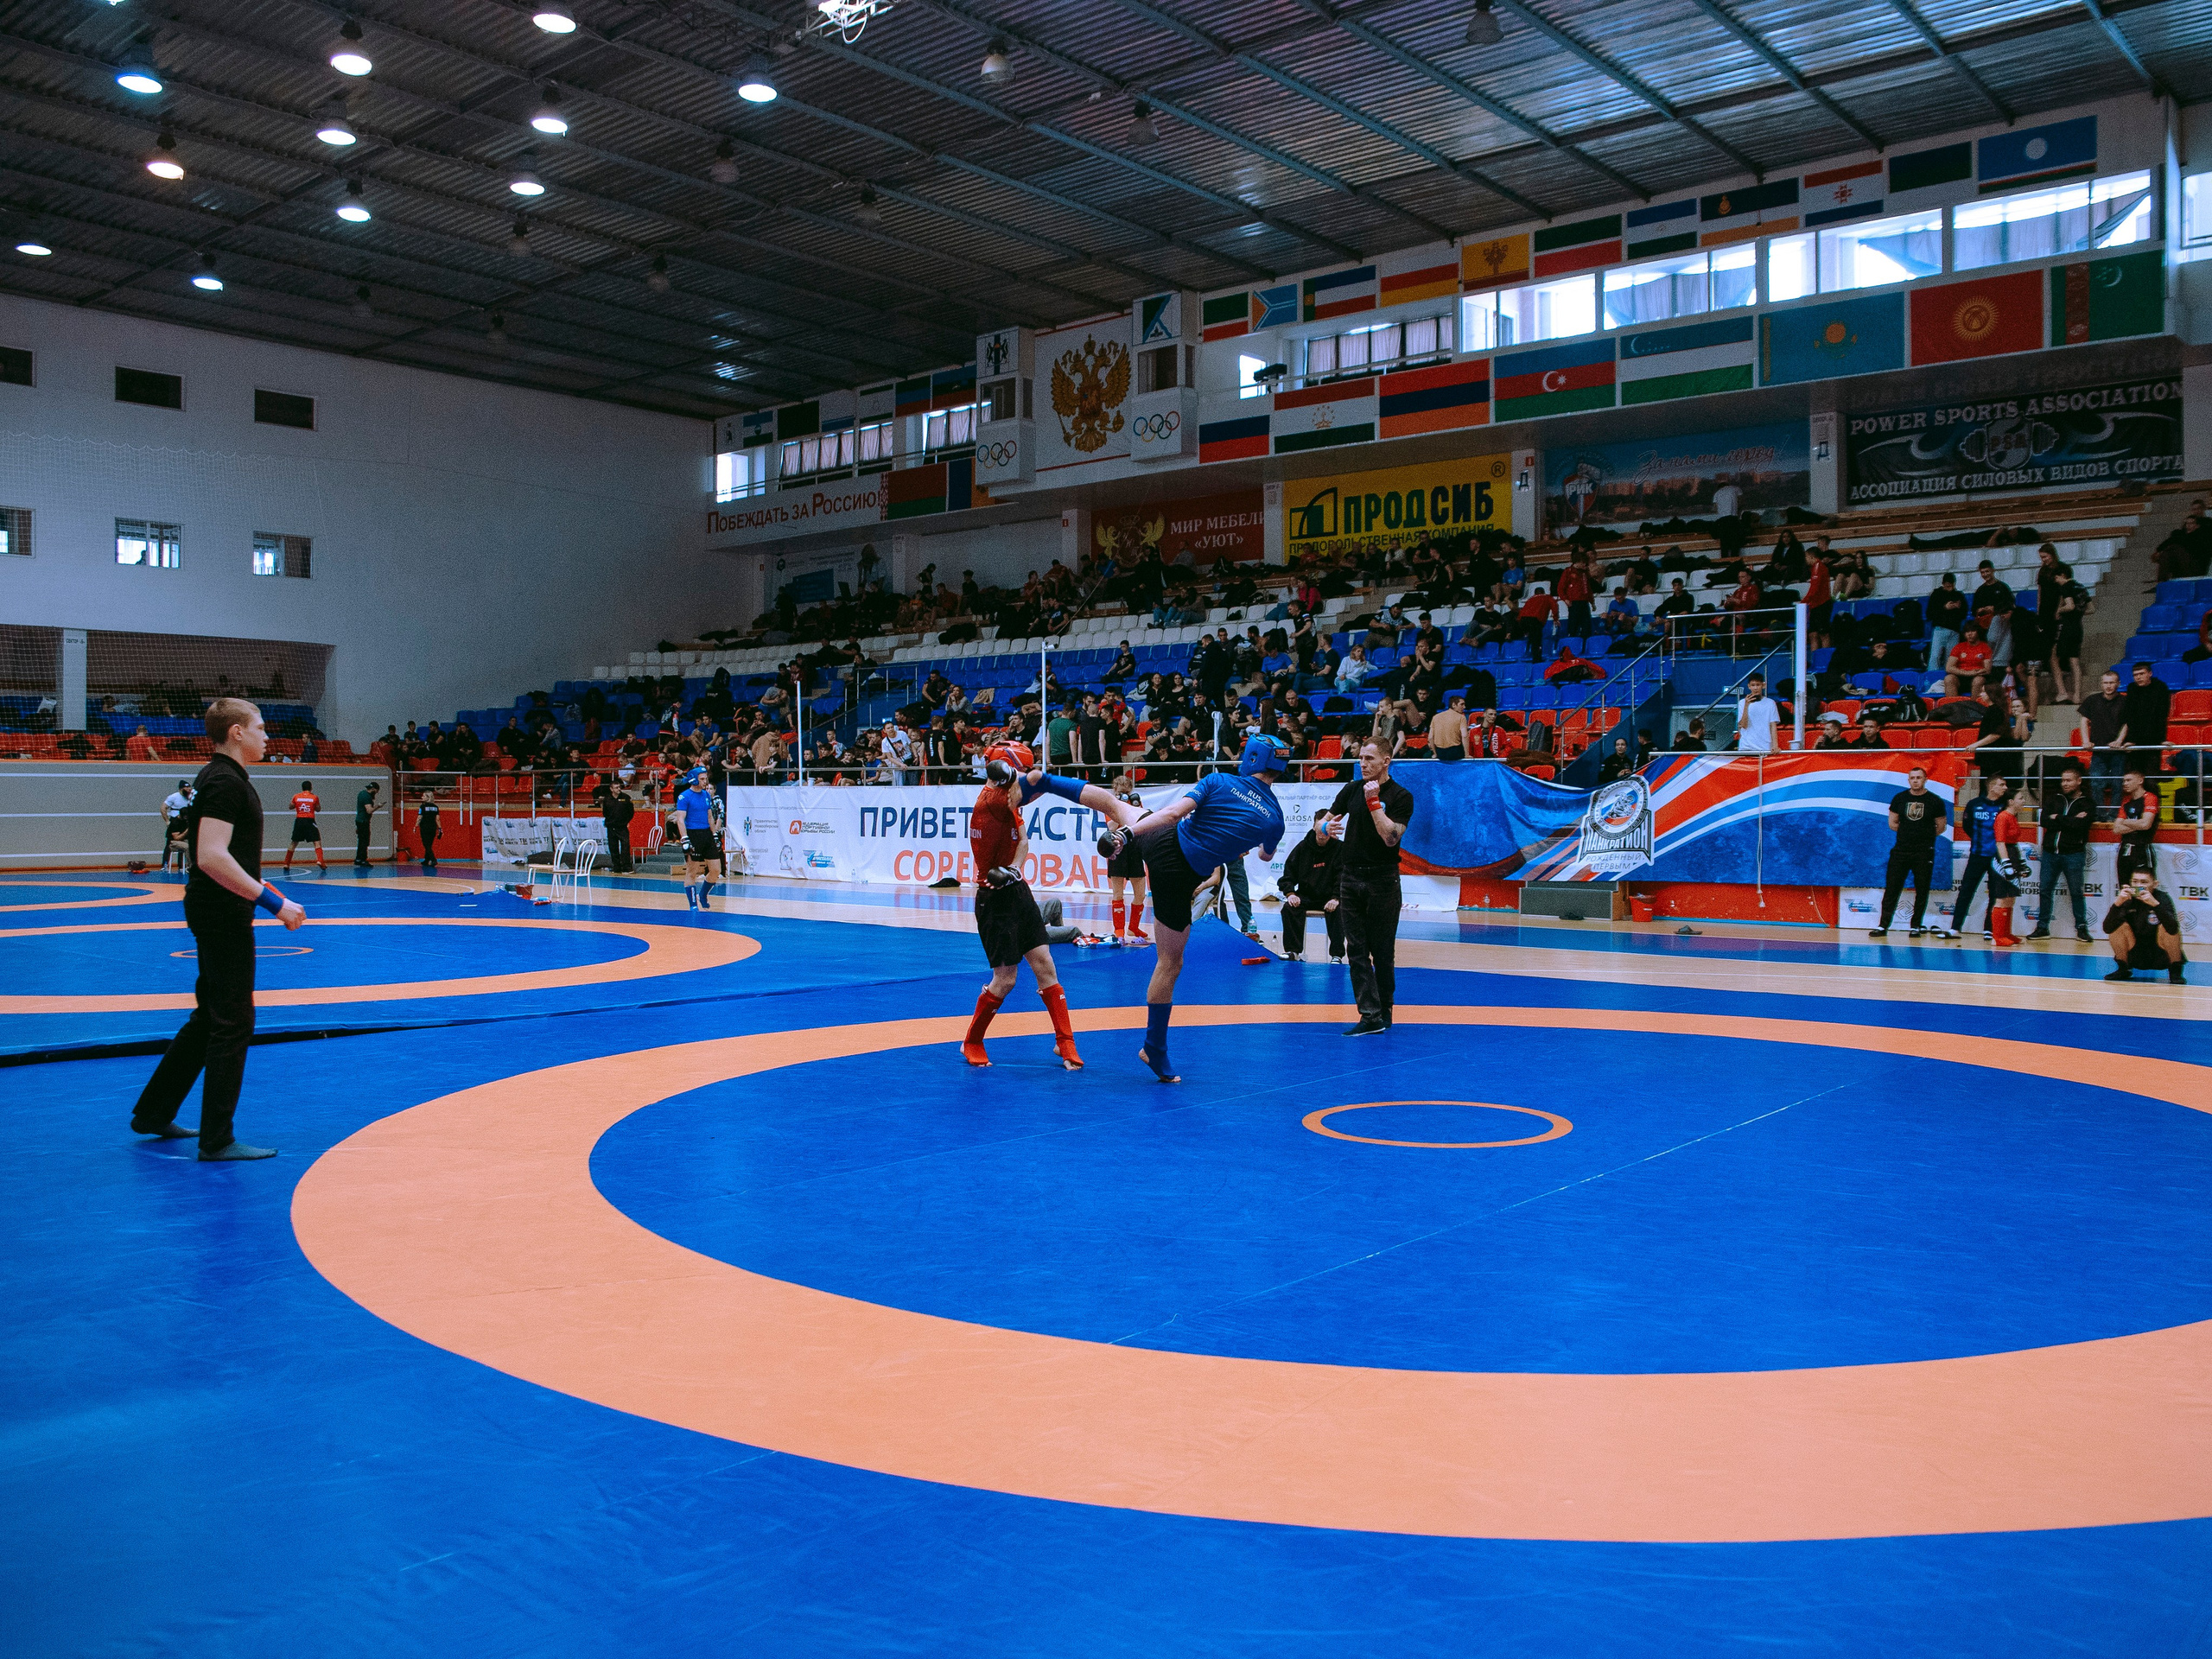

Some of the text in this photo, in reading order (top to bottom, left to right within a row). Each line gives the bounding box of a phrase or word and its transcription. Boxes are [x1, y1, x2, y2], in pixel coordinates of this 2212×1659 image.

[1850, 411, 1927, 435] POWER
[1934, 401, 2018, 425] SPORTS
[1669, 453, 1721, 468] нами
[1850, 475, 1957, 500] АССОЦИАЦИЯ
[1961, 467, 2045, 489] СИЛОВЫХ
[2050, 461, 2110, 480] ВИДОВ
[1568, 483, 1593, 496] РИК
[791, 503, 810, 520] ЗА
[1344, 481, 1494, 534] ПРОДСИБ
[1170, 518, 1203, 535] МИР
[1194, 532, 1244, 549] «УЮТ»
[1230, 787, 1272, 818] ПАНКРАТИОН
[1247, 790, 1262, 802] RUS
[1586, 853, 1642, 862] РОЖДЕННЫЙ
[2084, 883, 2104, 893] ВК
[2179, 886, 2209, 897] ТВК
